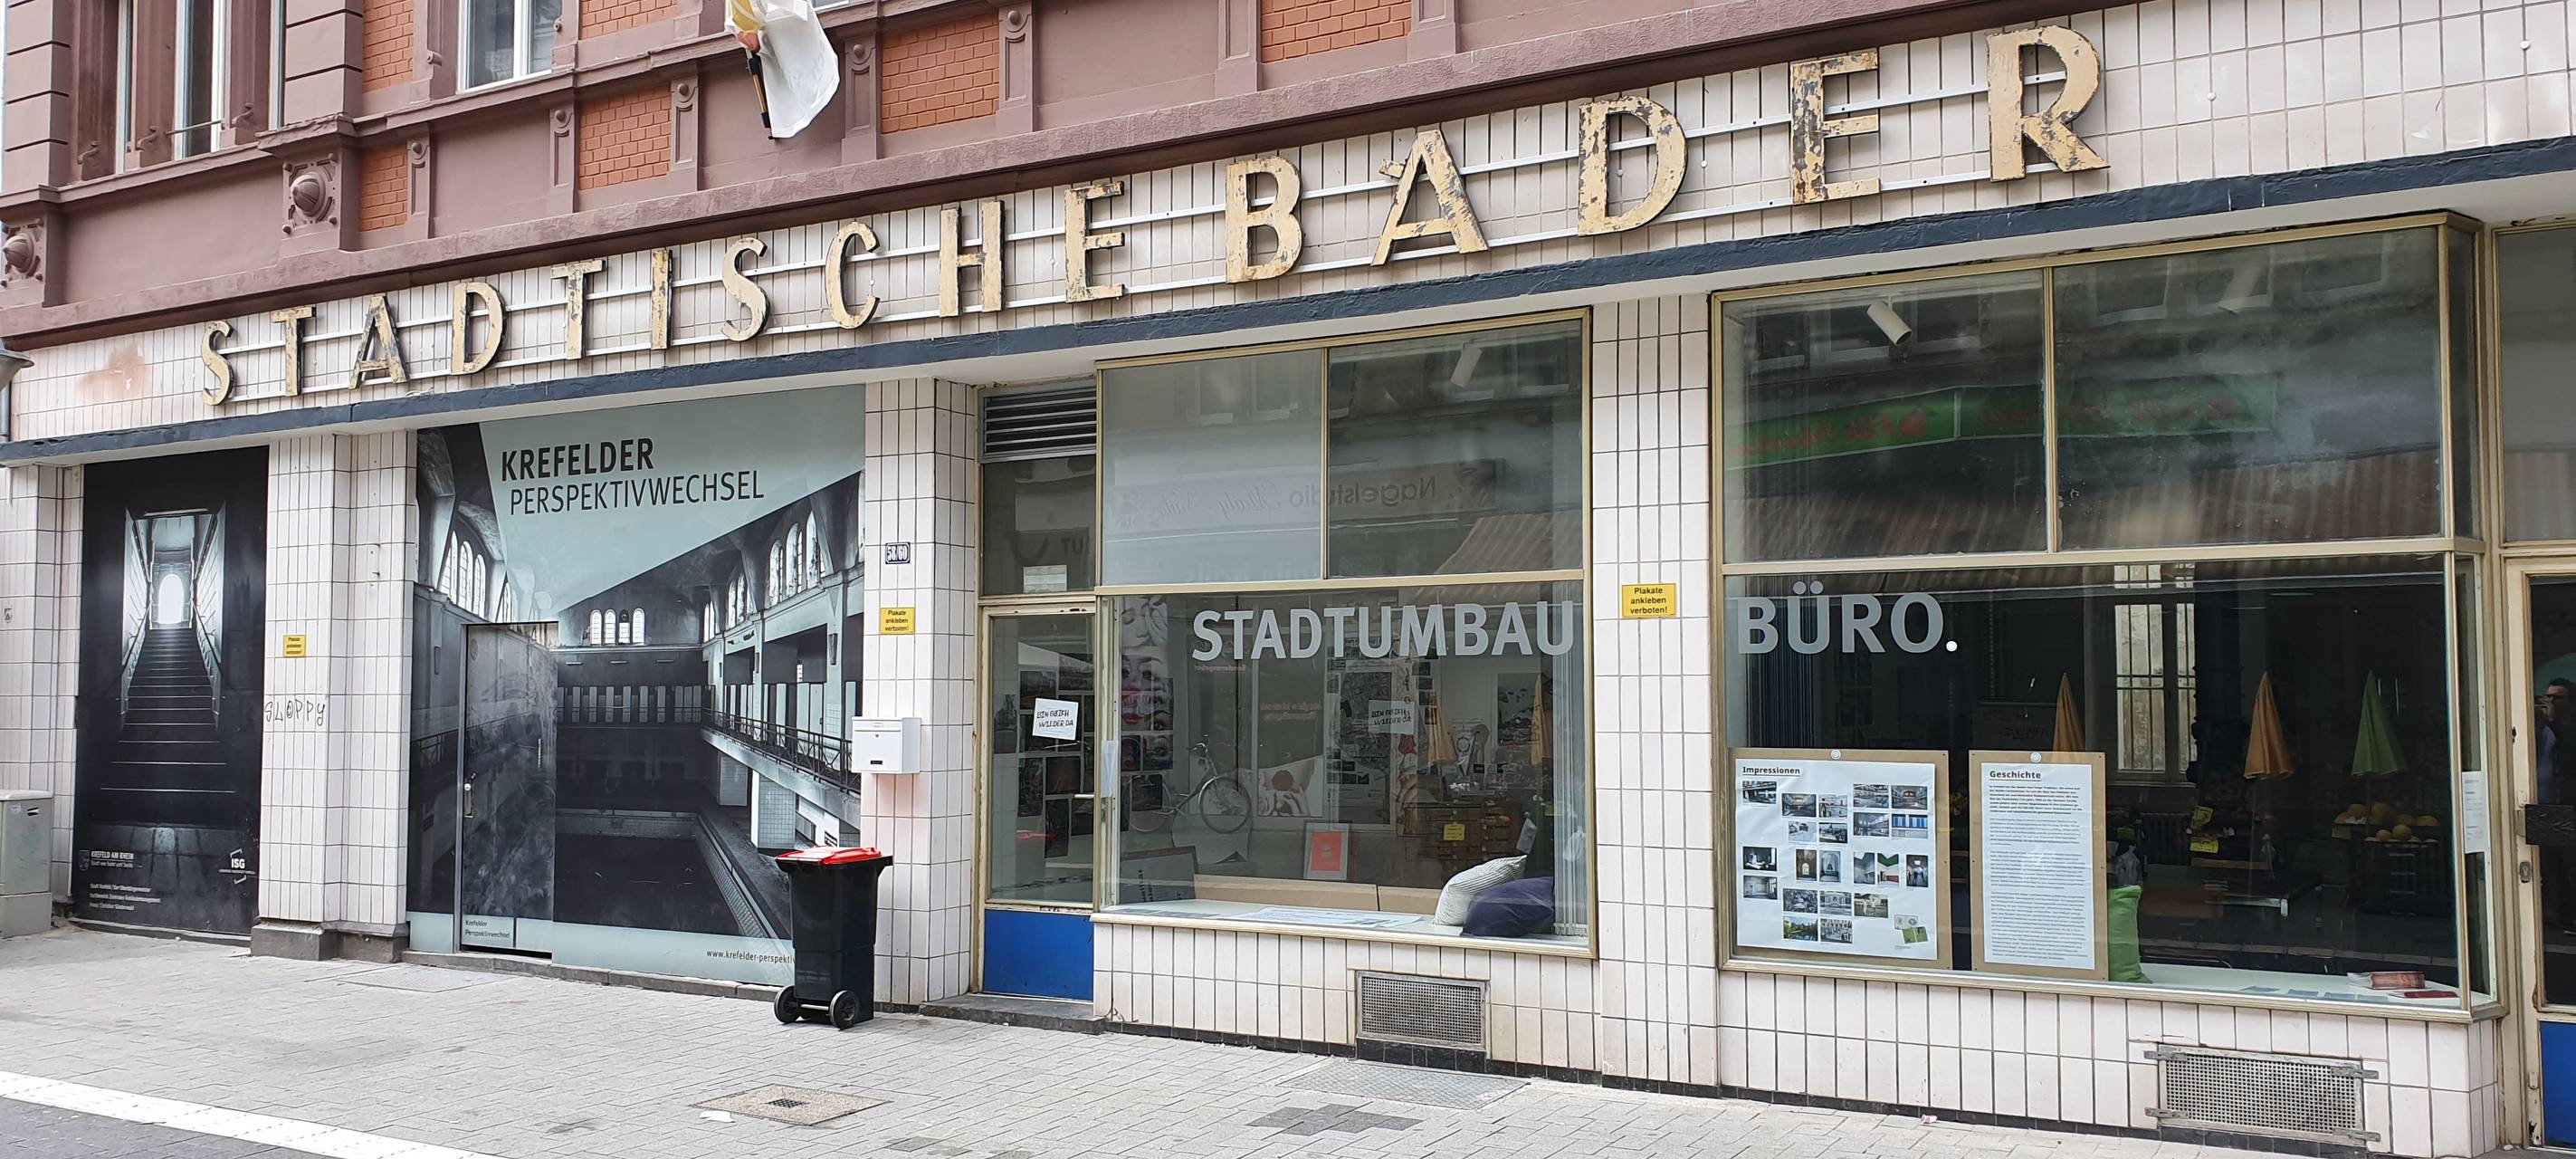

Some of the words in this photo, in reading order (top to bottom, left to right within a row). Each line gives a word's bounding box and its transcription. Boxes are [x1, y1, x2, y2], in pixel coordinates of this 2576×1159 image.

[501, 437, 654, 482] KREFELDER
[510, 470, 765, 515] PERSPEKTIVWECHSEL
[887, 545, 908, 560] 58/60
[1634, 587, 1663, 595] Plakate
[1630, 597, 1666, 605] ankleben
[1629, 606, 1668, 614] verboten!
[1191, 600, 1574, 661] STADTUMBAU
[1738, 580, 1958, 654] BÜRO.
[1742, 766, 1800, 775] Impressionen
[1989, 771, 2041, 779] Geschichte
[231, 857, 245, 869] ISG
